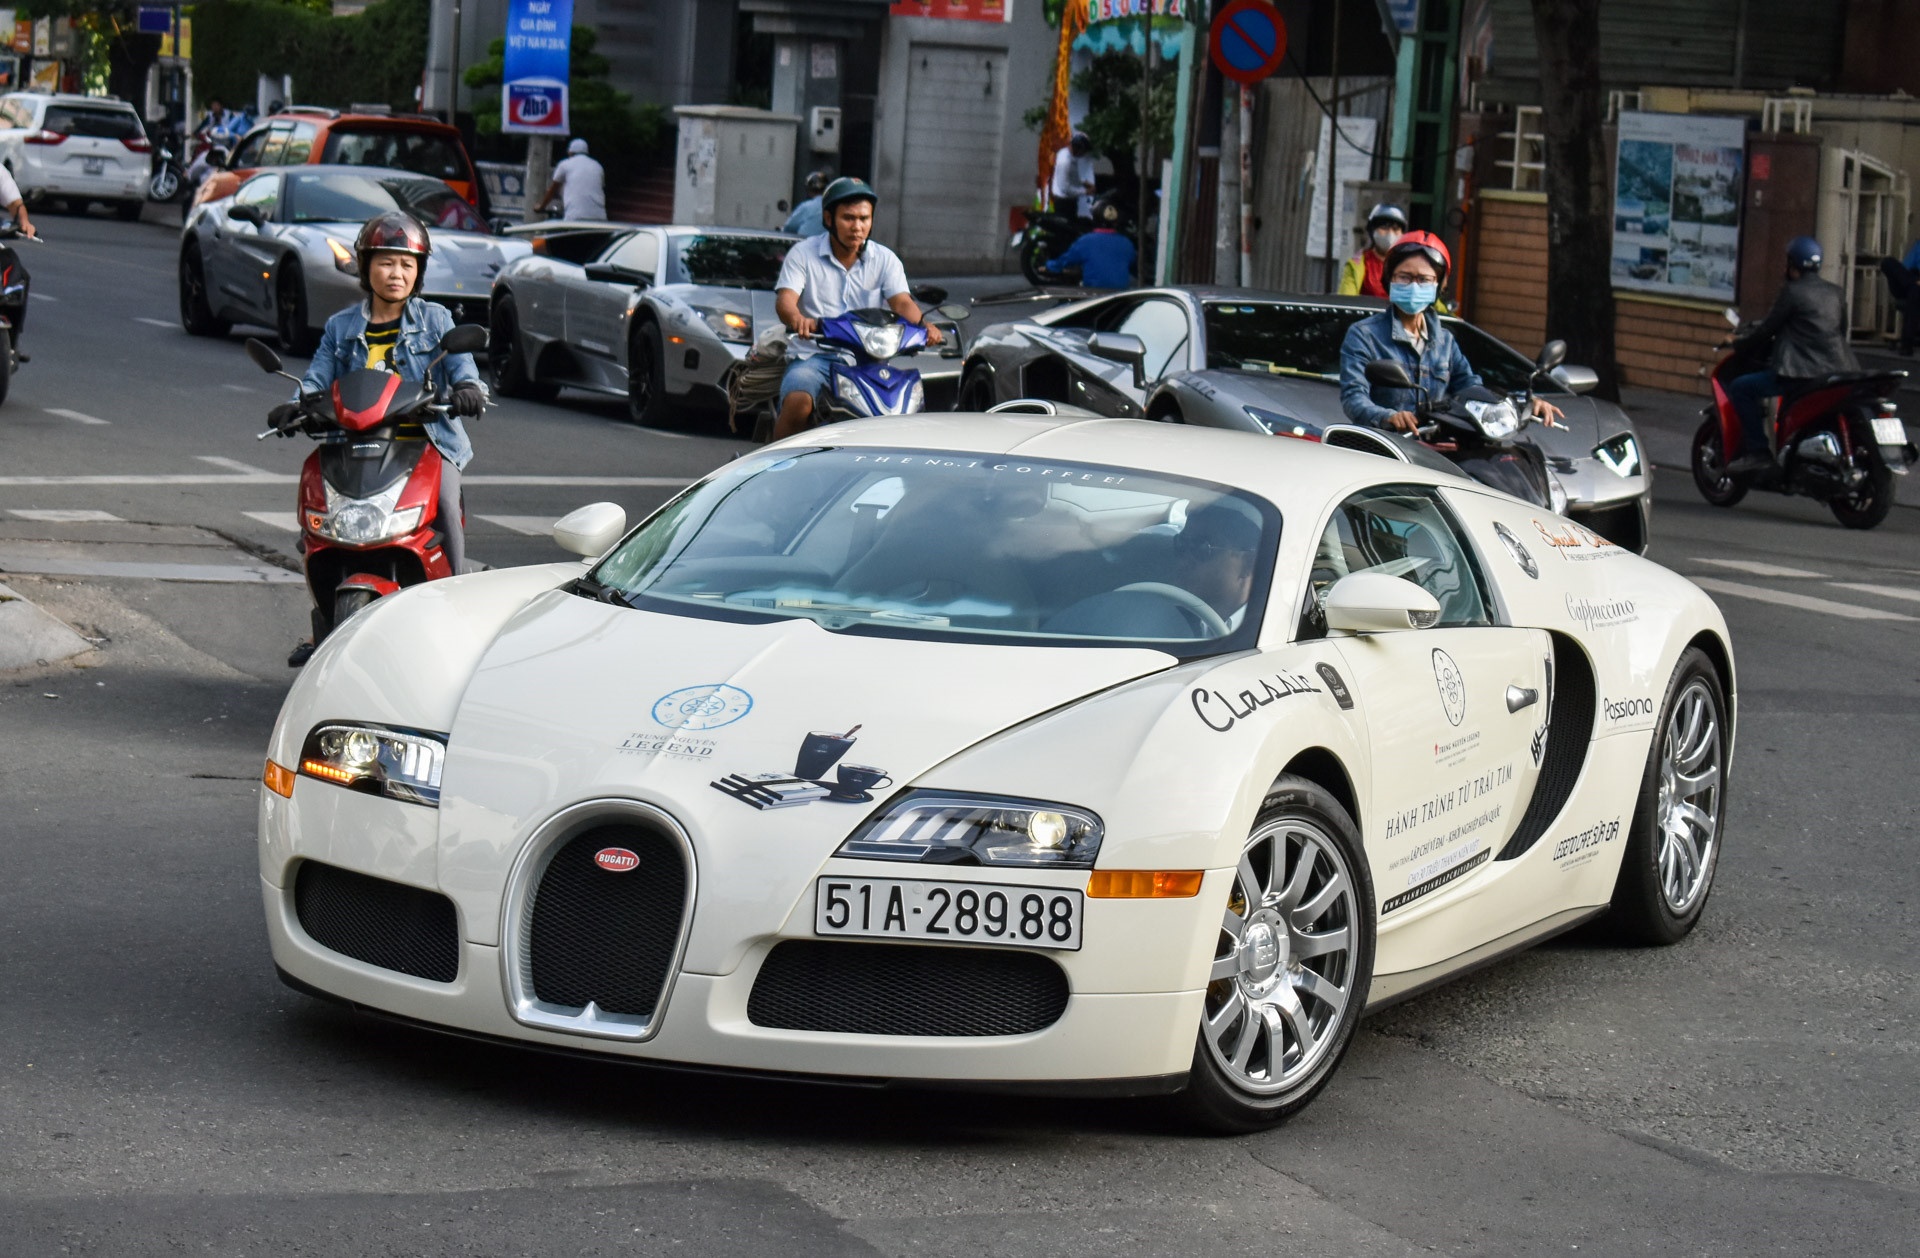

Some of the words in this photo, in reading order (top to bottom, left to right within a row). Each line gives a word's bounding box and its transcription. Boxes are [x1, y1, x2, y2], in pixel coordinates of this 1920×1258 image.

[520, 18, 535, 31] GIA
[527, 36, 547, 48] NAM
[523, 97, 549, 116] Aba
[854, 455, 912, 464] THE
[993, 464, 1125, 485] COFFEE!
[1565, 592, 1635, 631] Cappuccino
[1191, 668, 1322, 732] Classic
[1604, 697, 1652, 723] Passiona
[621, 739, 713, 756] LEGEND
[631, 732, 668, 741] TRUNG
[1385, 808, 1418, 839] HÀNH
[1422, 791, 1455, 822] TRÌNH
[1474, 770, 1494, 798] TRÁI
[1497, 763, 1512, 786] TIM
[598, 853, 635, 866] BUGATTI
[825, 883, 1074, 942] 51A-289.88
